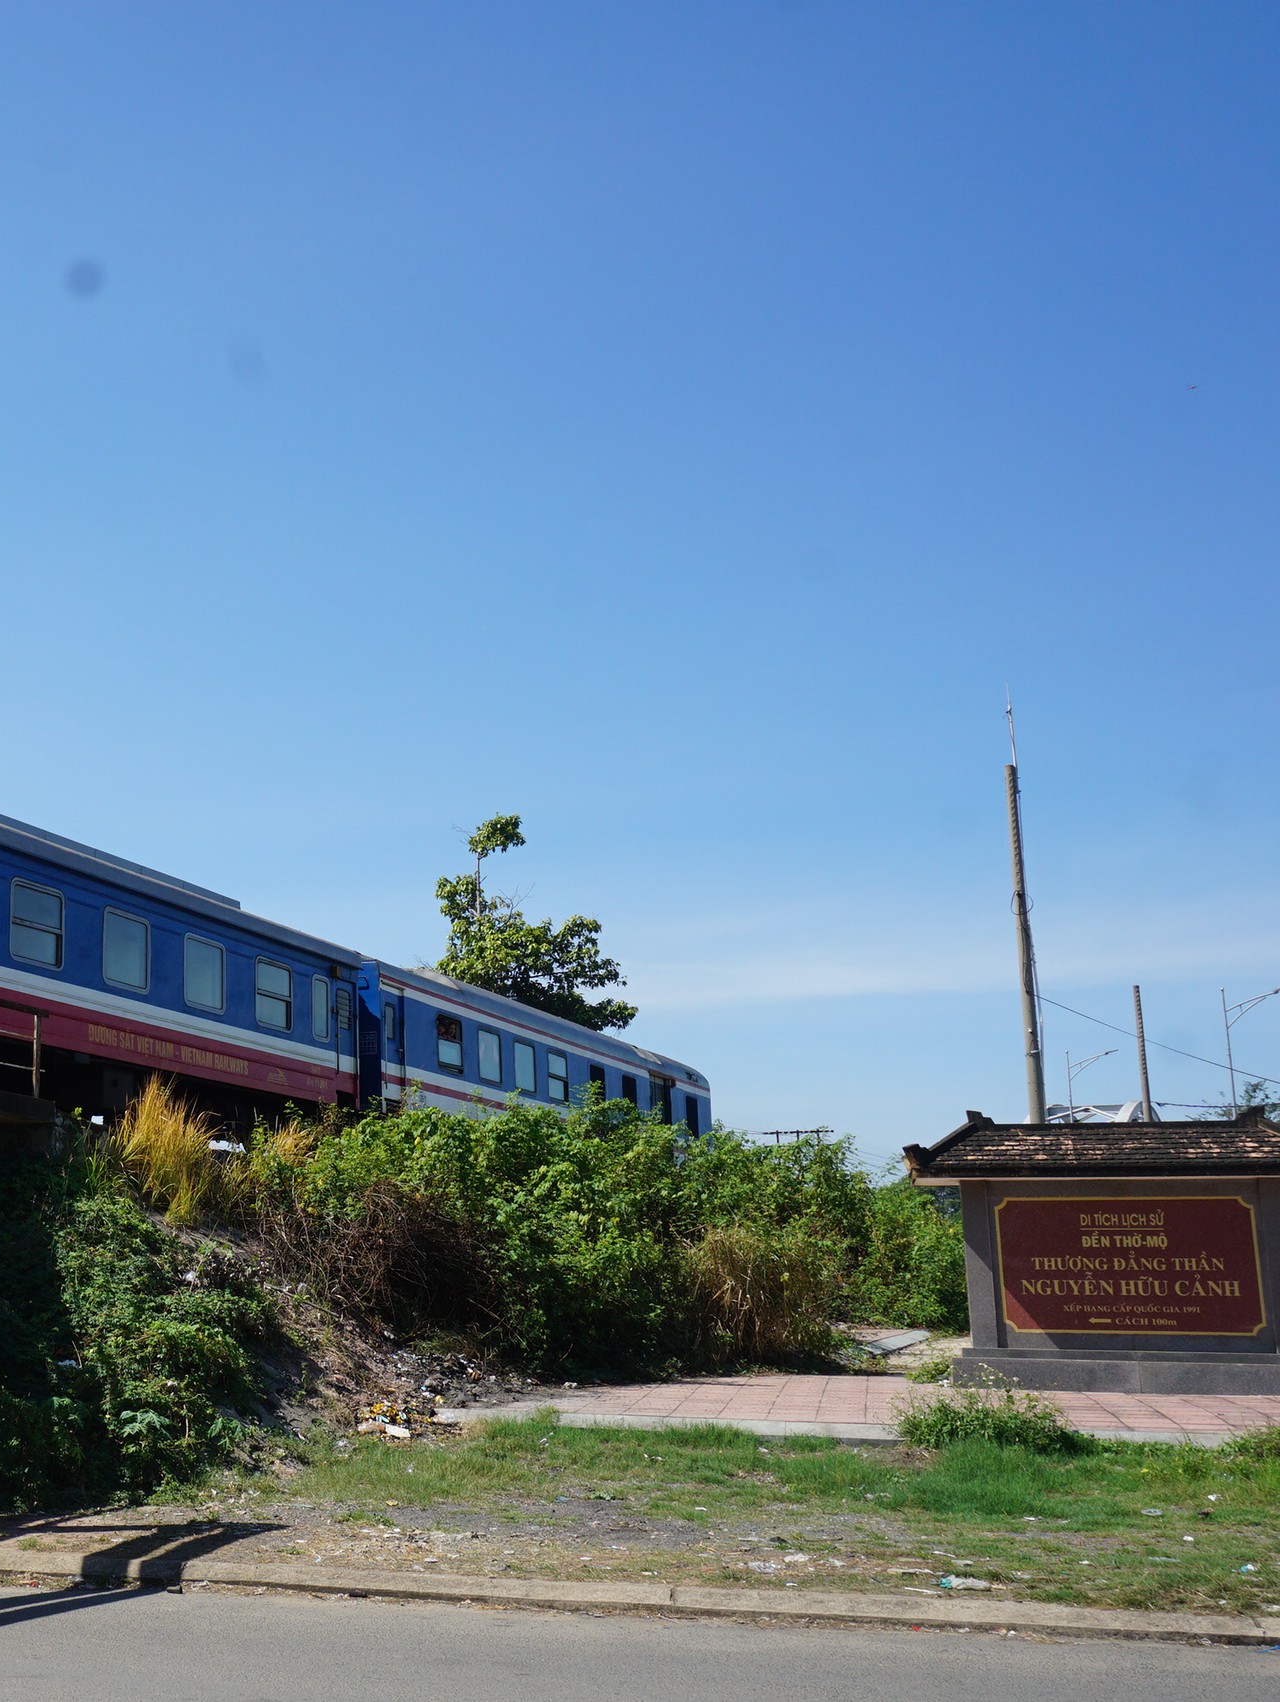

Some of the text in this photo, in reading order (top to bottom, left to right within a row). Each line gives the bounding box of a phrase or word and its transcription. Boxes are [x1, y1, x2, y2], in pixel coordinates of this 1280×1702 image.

[155, 1040, 174, 1059] NAM
[181, 1045, 213, 1068] VIETNAM
[214, 1052, 249, 1076] RAILWAYS
[1080, 1209, 1164, 1228] DI TÍCH LỊCH SỬ
[1082, 1230, 1110, 1248] ĐỀN
[1031, 1250, 1225, 1272] THƯỢNG ĐẲNG THẦN
[1020, 1272, 1242, 1297] NGUYỄN HỮU CẢNH
[1063, 1302, 1082, 1312] XẾP
[1113, 1303, 1132, 1312] CẤP
[1134, 1303, 1161, 1314] QUỐC
[1116, 1316, 1148, 1326] CÁCH
